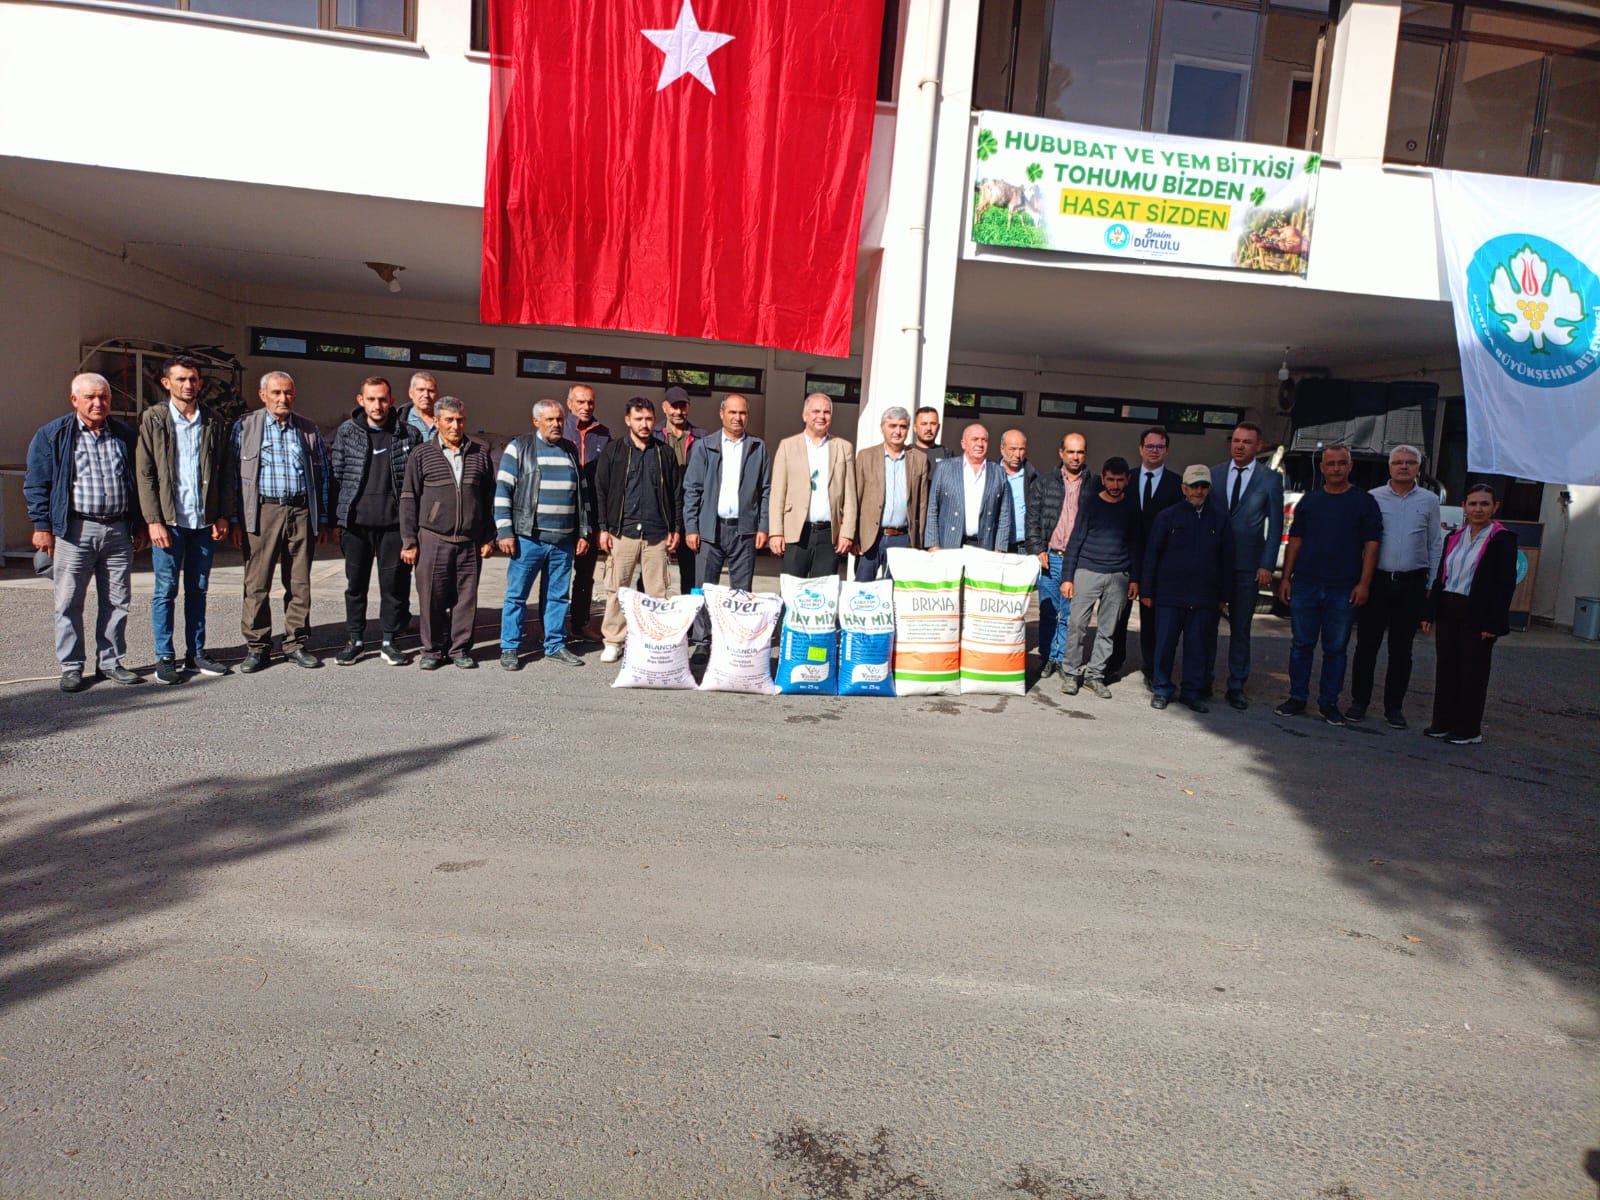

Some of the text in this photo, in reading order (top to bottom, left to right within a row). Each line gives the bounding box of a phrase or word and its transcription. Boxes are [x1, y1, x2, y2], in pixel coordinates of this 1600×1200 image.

[1004, 130, 1295, 180] HUBUBAT VE YEM BİTKİSİ
[1054, 163, 1244, 200] TOHUMU BİZDEN
[1063, 195, 1227, 230] HASAT SİZDEN
[1133, 238, 1180, 251] DUTLULU
[1495, 347, 1577, 382] BÜYÜKŞEHİR
[641, 598, 676, 612] ayer
[722, 598, 760, 613] ayer
[912, 597, 955, 612] BRIXIA
[979, 598, 1023, 614] BRIXIA
